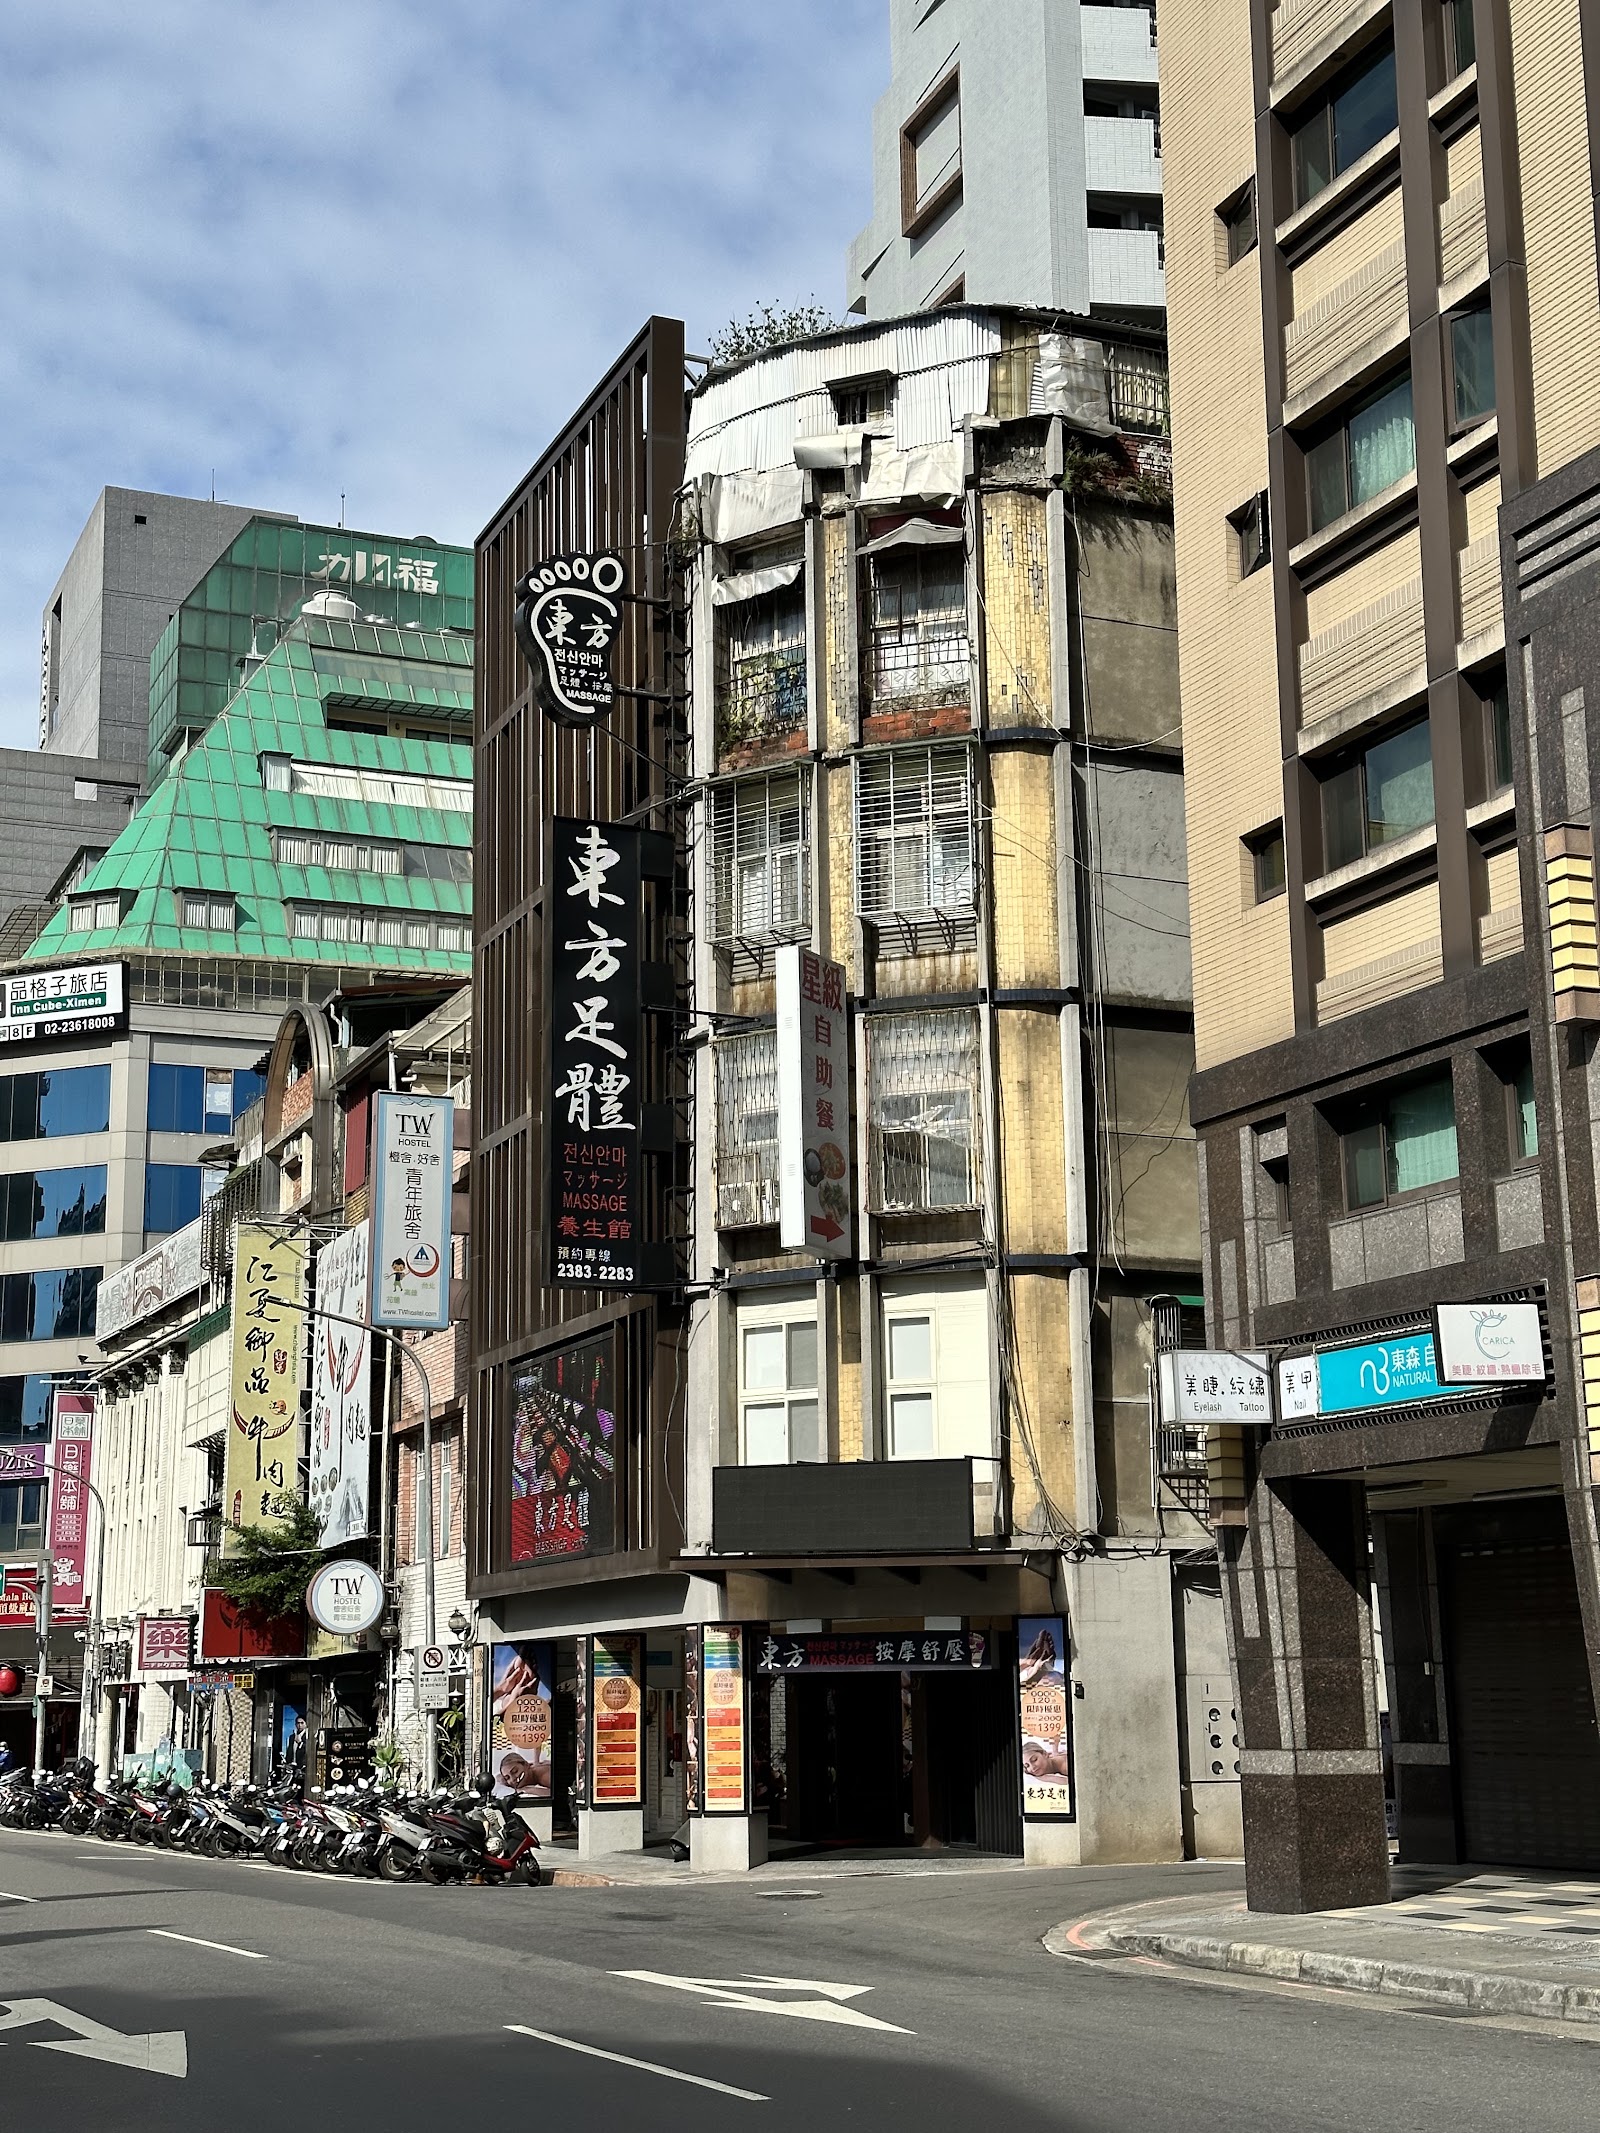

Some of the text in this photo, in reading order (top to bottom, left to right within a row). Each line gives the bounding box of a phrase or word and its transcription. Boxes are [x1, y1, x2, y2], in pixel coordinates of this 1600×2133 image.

[545, 598, 613, 648] 東方
[554, 648, 604, 668] 전신안마
[558, 665, 608, 681] マッサージ
[566, 688, 612, 703] MASSAGE
[11, 971, 107, 1000] 品格子旅店
[555, 825, 636, 1131] 東方足體
[802, 953, 843, 1014] 星級
[12, 997, 101, 1015] Inn Cube-Ximen
[44, 1016, 115, 1035] 02-23618008
[814, 1014, 835, 1132] 自助餐
[396, 1113, 435, 1135] TW
[398, 1138, 432, 1148] HOSTEL
[563, 1142, 627, 1167] 전신안마
[563, 1171, 628, 1190] マッサージ
[404, 1168, 423, 1240] 青年旅舍
[562, 1191, 627, 1212] MASSAGE
[557, 1214, 632, 1239] 養生館
[557, 1246, 611, 1262] 預約專線
[557, 1263, 634, 1281] 2383-2283
[1482, 1336, 1516, 1345] CARICA
[1285, 1370, 1312, 1394] 美甲
[1392, 1370, 1433, 1388] NATURAL
[1194, 1402, 1265, 1413] Eyelash Tattoo
[1294, 1400, 1307, 1410] Nail
[330, 1574, 366, 1595] TW
[146, 1622, 189, 1658] 藥
[760, 1636, 805, 1670] 東方
[809, 1653, 875, 1666] MASSAGE
[876, 1638, 965, 1663] 按摩舒壓
[512, 1714, 547, 1723] 限時優惠
[1038, 1723, 1061, 1732] 1399
[522, 1733, 546, 1743] 1399
